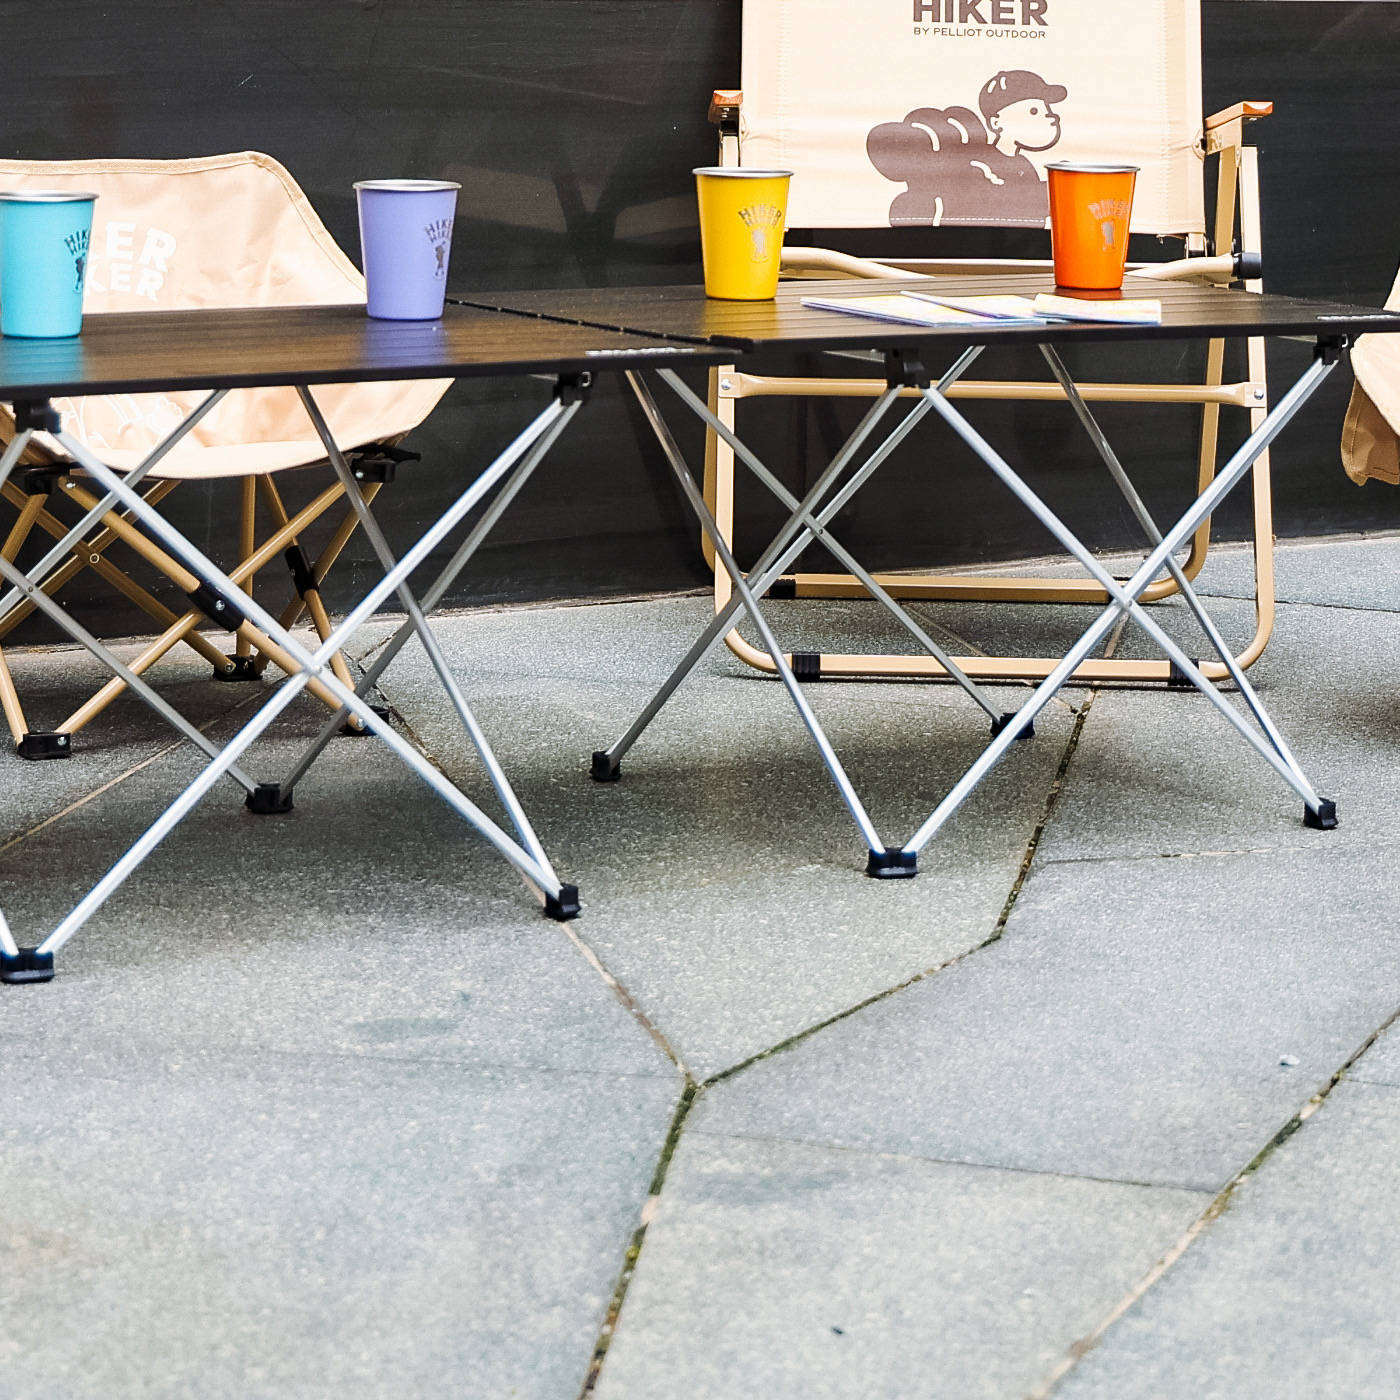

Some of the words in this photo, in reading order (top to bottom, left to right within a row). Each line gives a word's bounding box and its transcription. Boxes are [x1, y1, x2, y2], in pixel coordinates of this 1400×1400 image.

[913, 26, 930, 36] BY
[933, 27, 983, 38] PELLIOT
[985, 28, 1046, 39] OUTDOOR
[84, 262, 164, 303] KER
